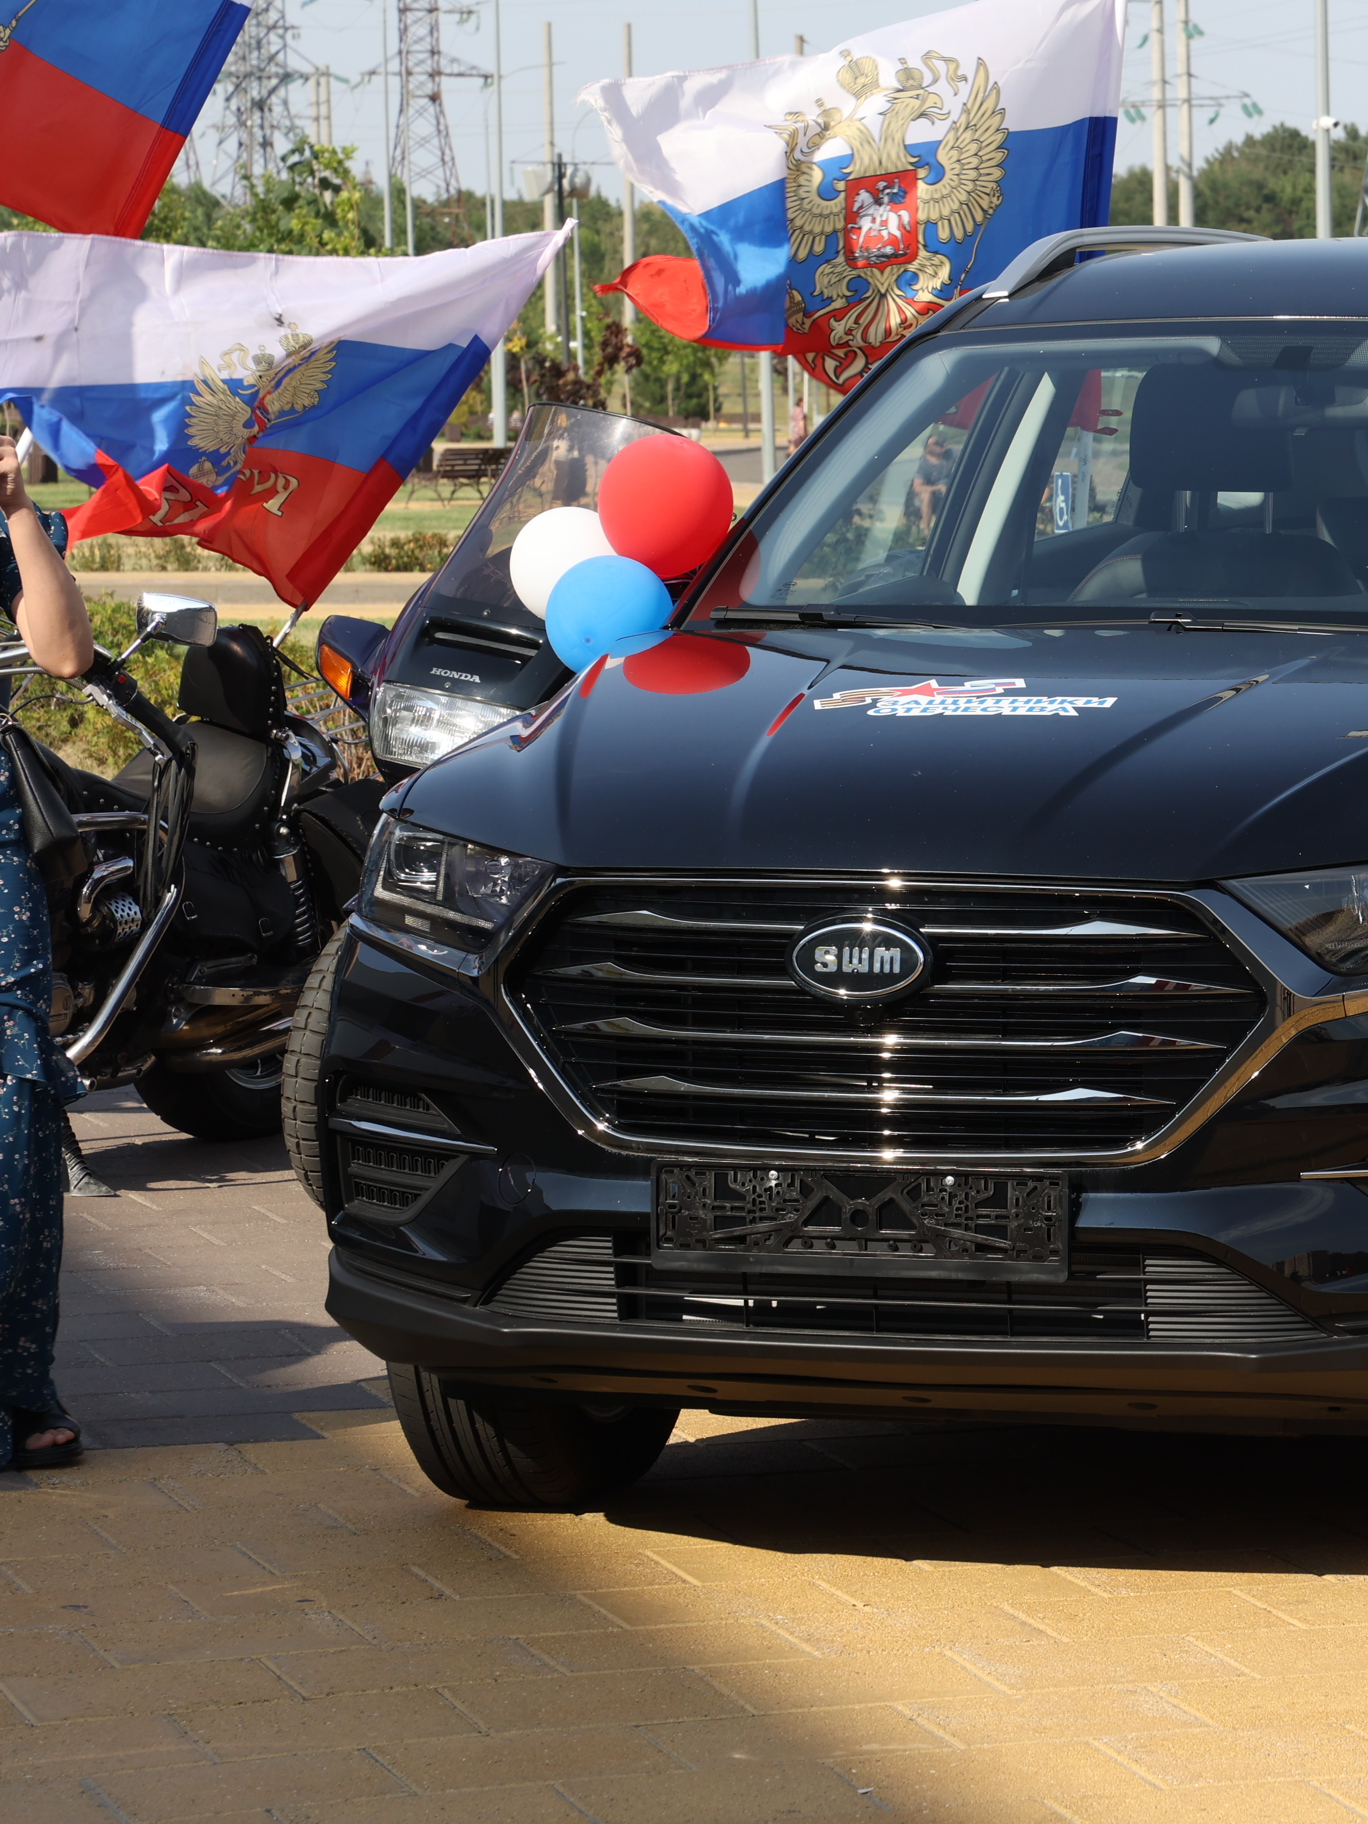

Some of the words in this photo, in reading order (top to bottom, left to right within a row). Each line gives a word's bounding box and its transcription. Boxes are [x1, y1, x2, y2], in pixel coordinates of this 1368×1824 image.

[430, 667, 481, 683] HONDA
[880, 698, 1109, 706] ЗАЩИТНИКИ
[873, 706, 1069, 714] ОТЕЧЕСТВА
